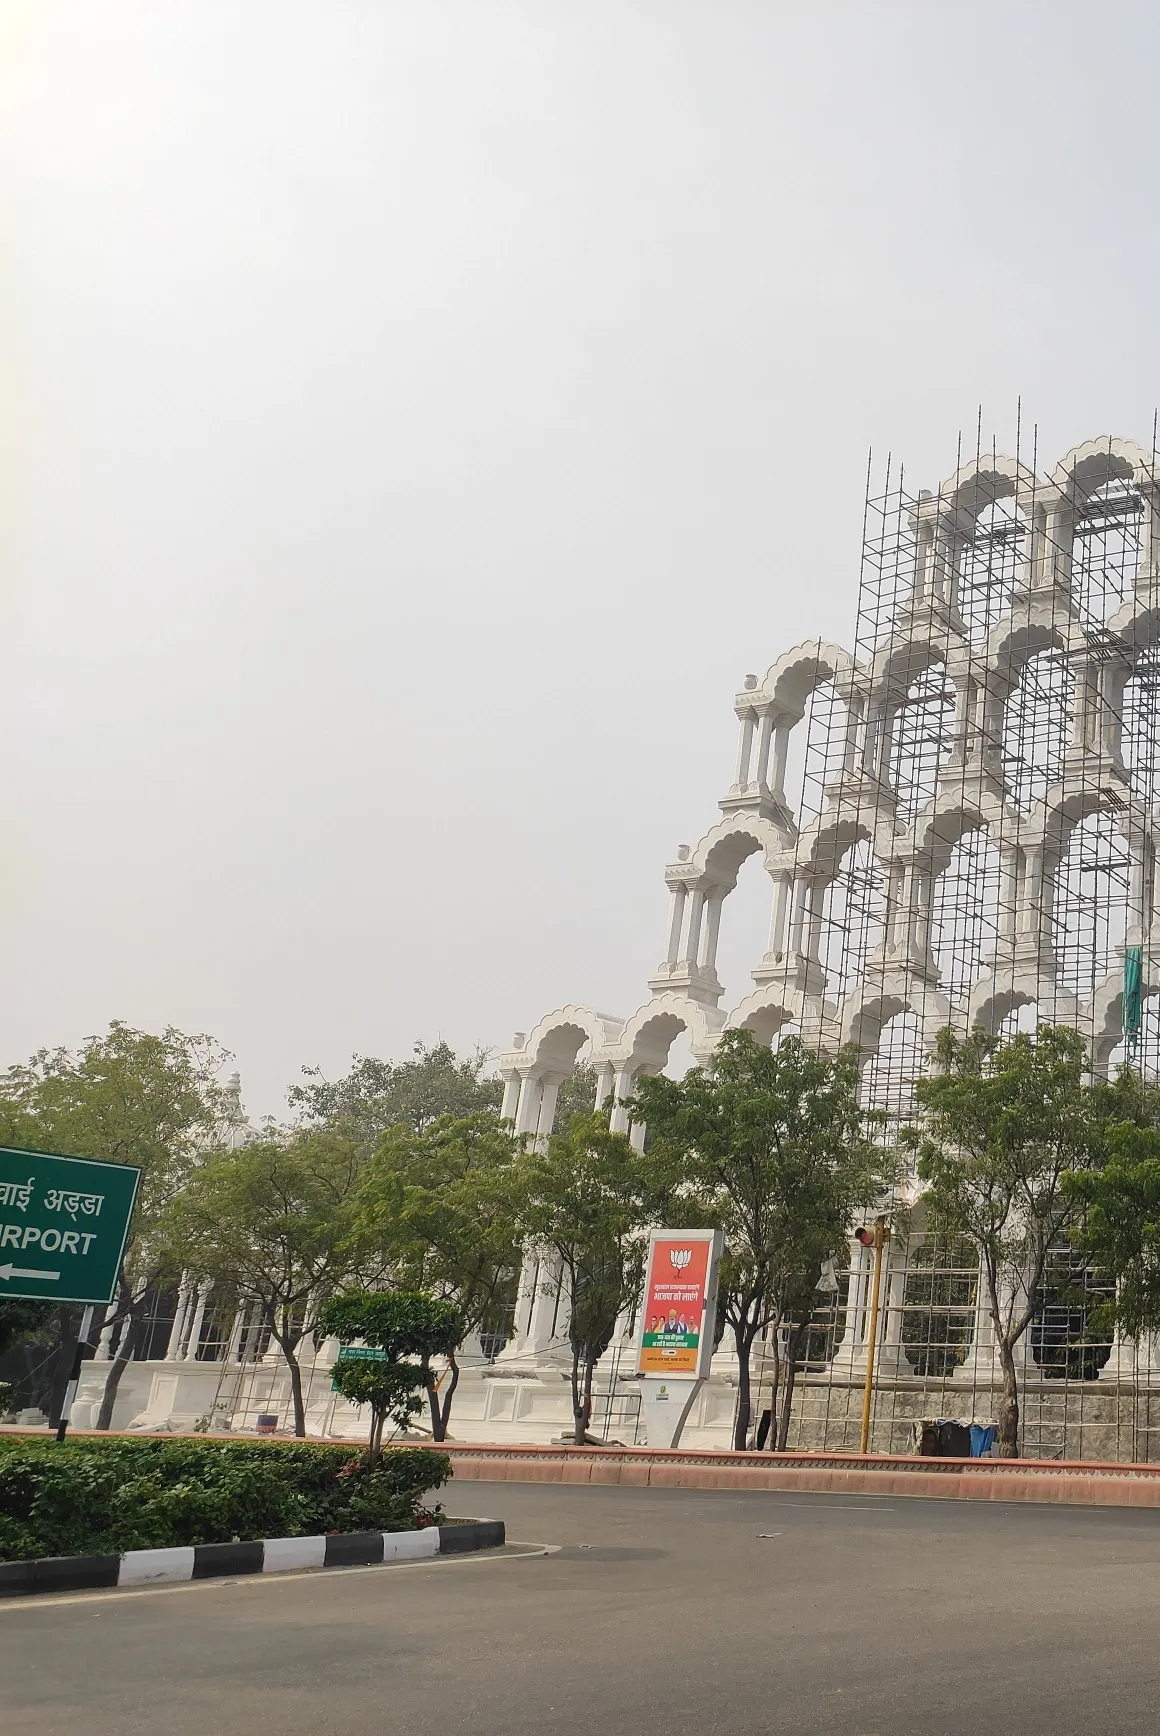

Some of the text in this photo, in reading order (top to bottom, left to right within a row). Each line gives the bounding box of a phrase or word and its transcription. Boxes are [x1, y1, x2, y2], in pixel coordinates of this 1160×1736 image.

[43, 1189, 105, 1222] अड्डा
[0, 1223, 97, 1255] RPORT
[653, 1292, 673, 1301] भाजपा
[673, 1290, 682, 1301] को
